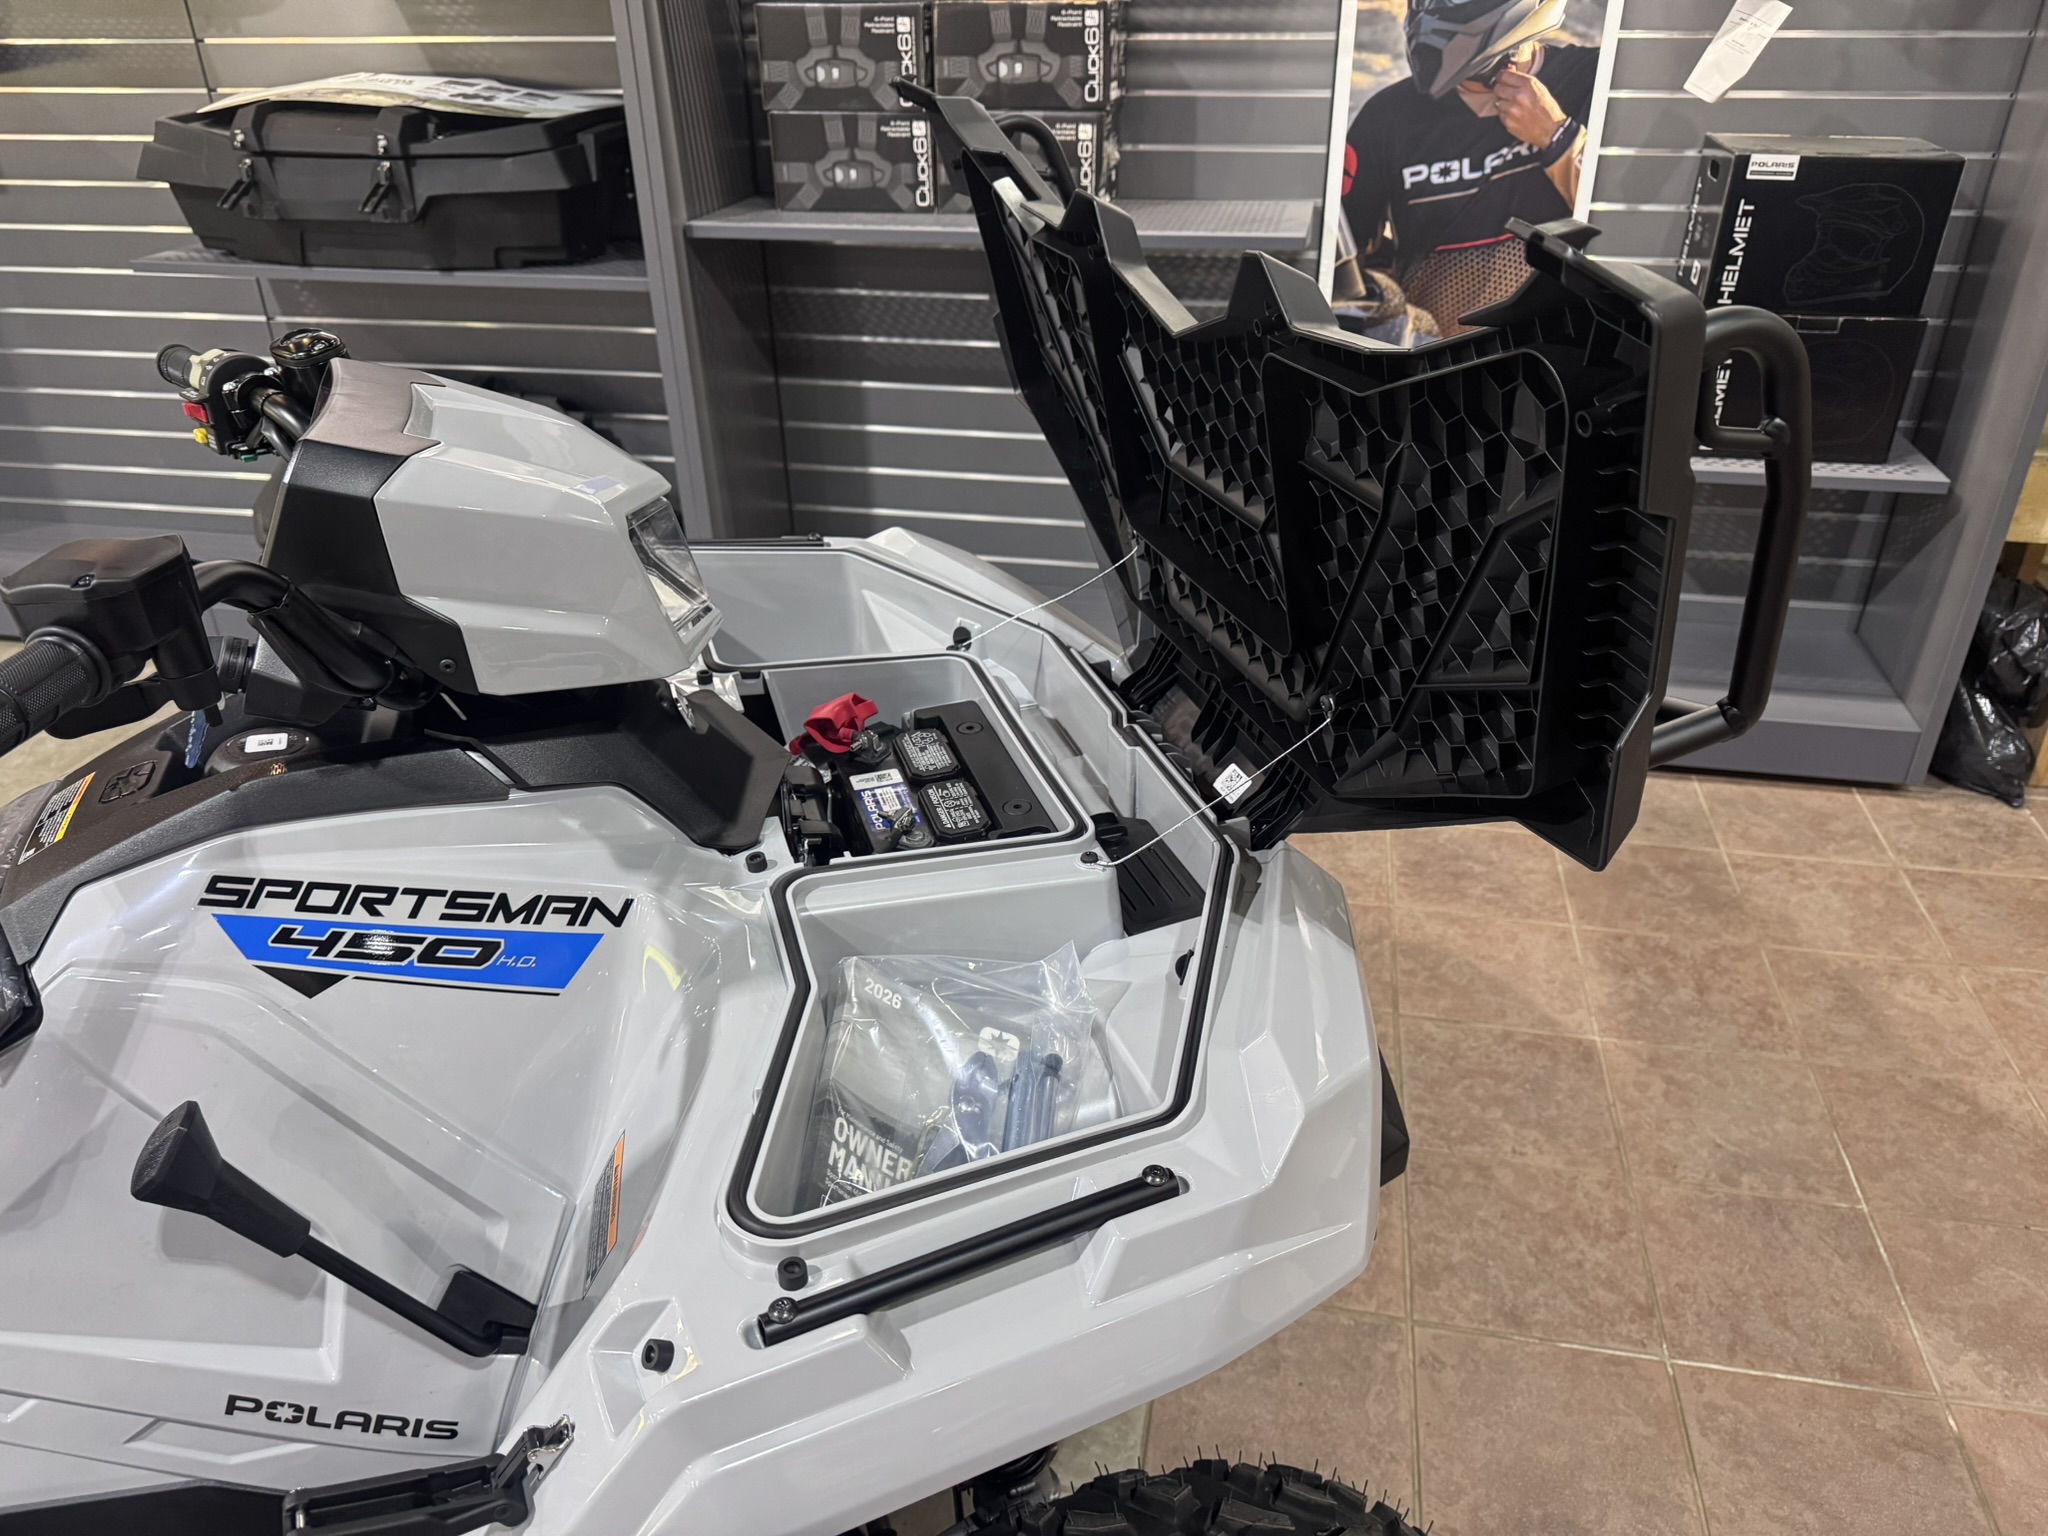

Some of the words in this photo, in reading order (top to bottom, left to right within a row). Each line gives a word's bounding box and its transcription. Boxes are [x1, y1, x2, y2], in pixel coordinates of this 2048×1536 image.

[1402, 141, 1540, 190] POLAR
[1751, 161, 1796, 169] POLARIS
[1717, 198, 1756, 304] HELMET
[198, 875, 635, 928] SPORTSMAN
[268, 924, 505, 970] 450
[864, 977, 902, 1009] 2026
[224, 1394, 459, 1440] POLARIS
